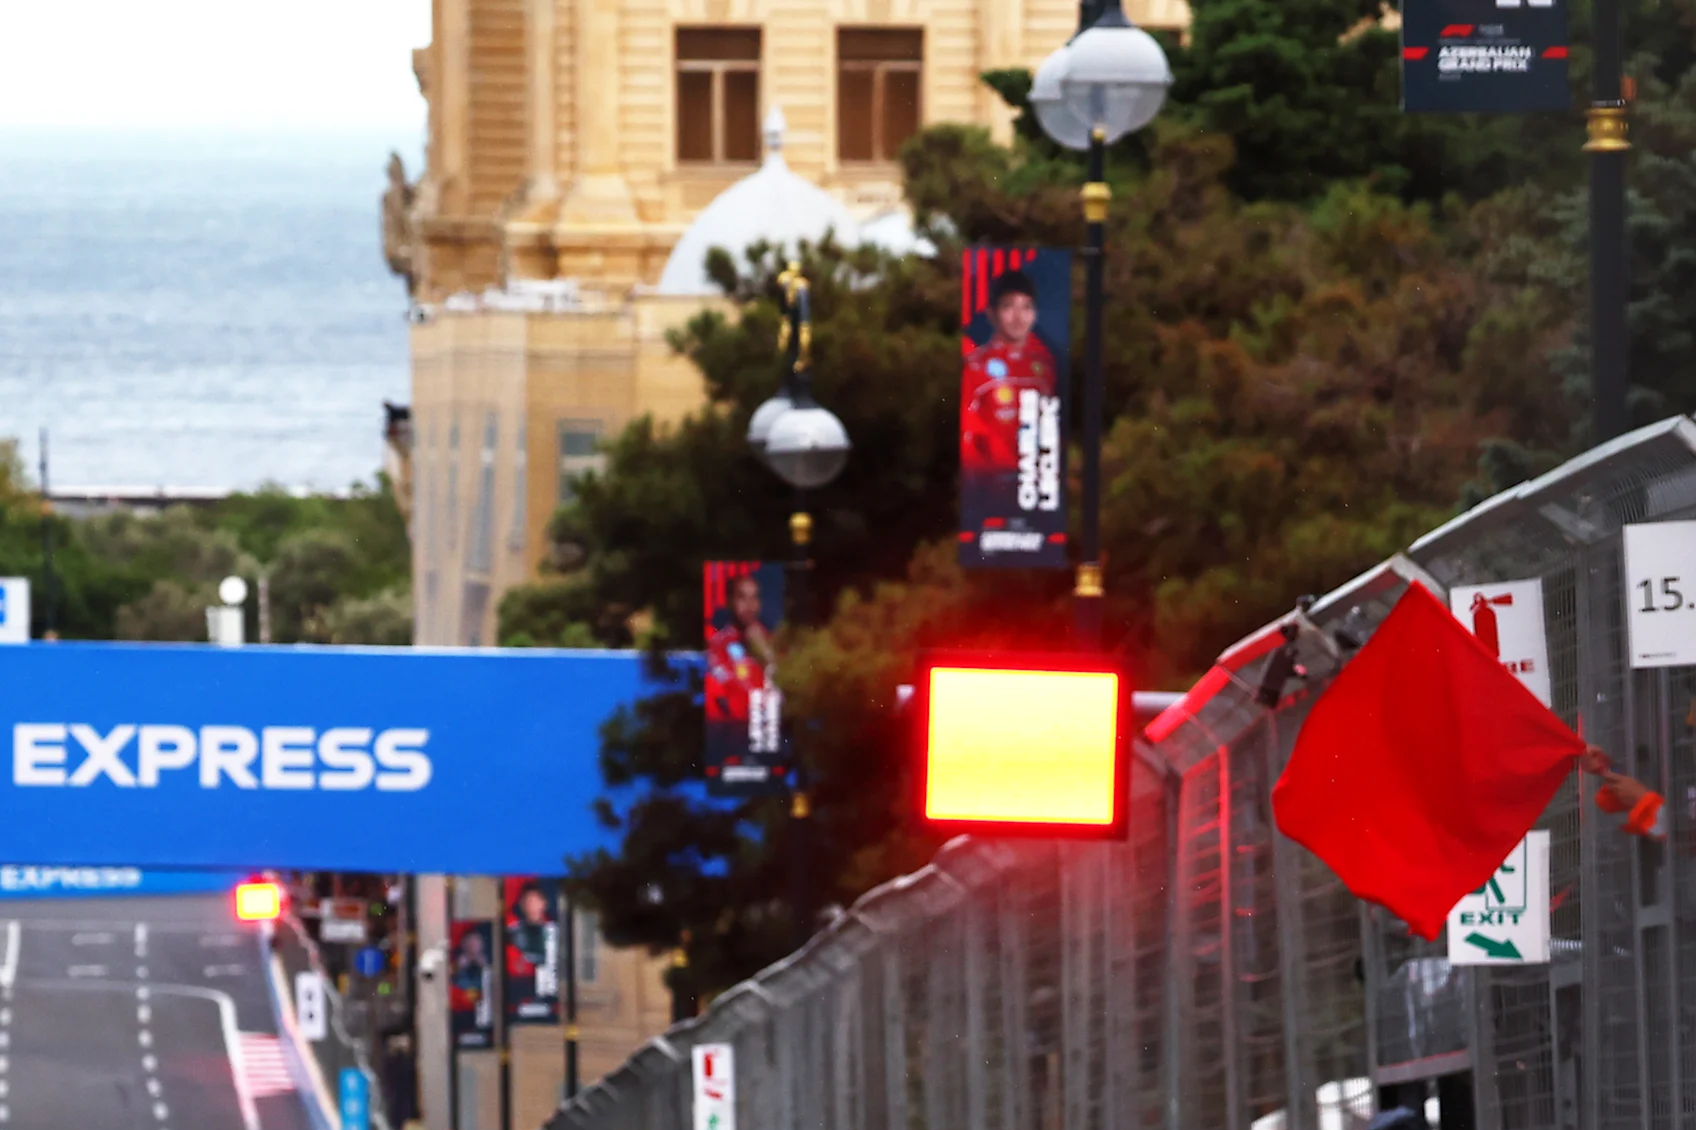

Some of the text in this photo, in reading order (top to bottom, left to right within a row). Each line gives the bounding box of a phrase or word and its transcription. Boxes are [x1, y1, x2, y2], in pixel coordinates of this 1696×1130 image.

[1438, 46, 1532, 58] AZERBAIJAN
[1438, 58, 1528, 71] GRAND PRIX
[13, 723, 432, 791] EXPRESS
[1459, 910, 1524, 927] EXIT
